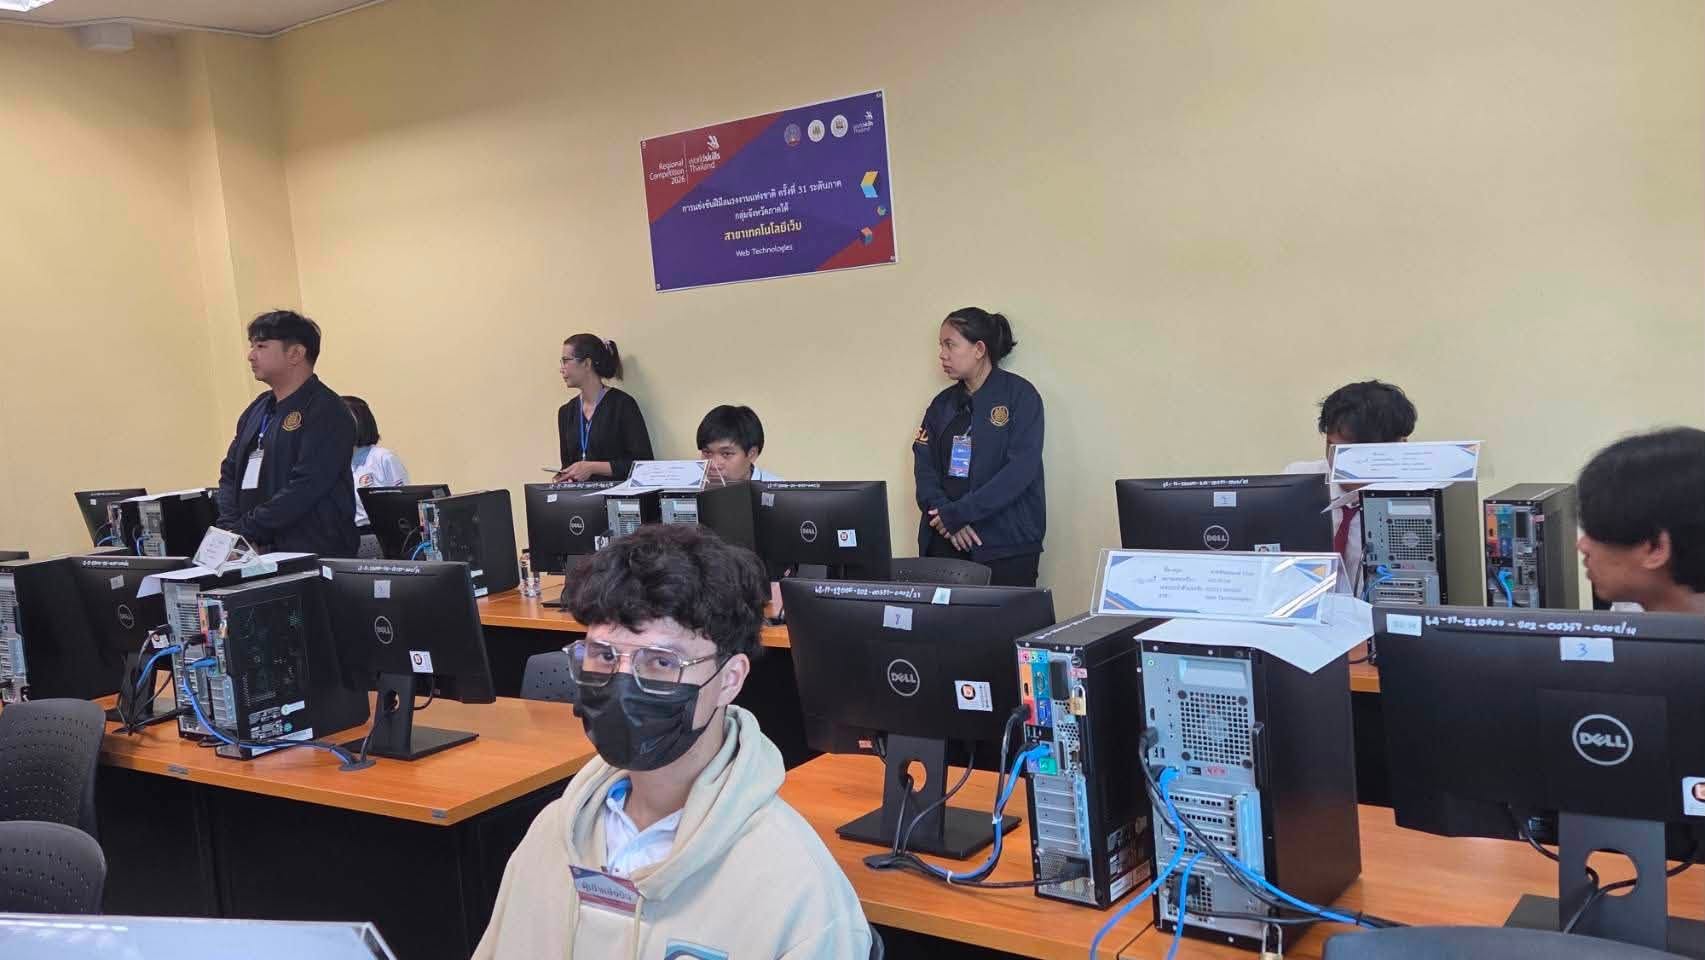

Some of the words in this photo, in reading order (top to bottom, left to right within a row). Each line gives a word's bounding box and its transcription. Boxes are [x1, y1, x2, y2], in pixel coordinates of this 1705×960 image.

[658, 158, 684, 171] Regional
[688, 161, 716, 173] Thailand
[649, 168, 685, 181] Competition
[671, 175, 686, 185] 2026
[798, 185, 807, 195] 31
[735, 202, 790, 222] กลุ่มจังหวัดภาคใต้
[724, 219, 802, 242] สาขาเทคโนโลยีเว็บ
[735, 248, 751, 258] Web
[752, 244, 793, 257] Technologies
[1206, 534, 1227, 542] DELL
[1575, 642, 1588, 658] 3
[890, 671, 917, 684] DELL
[1578, 730, 1627, 749] DELL
